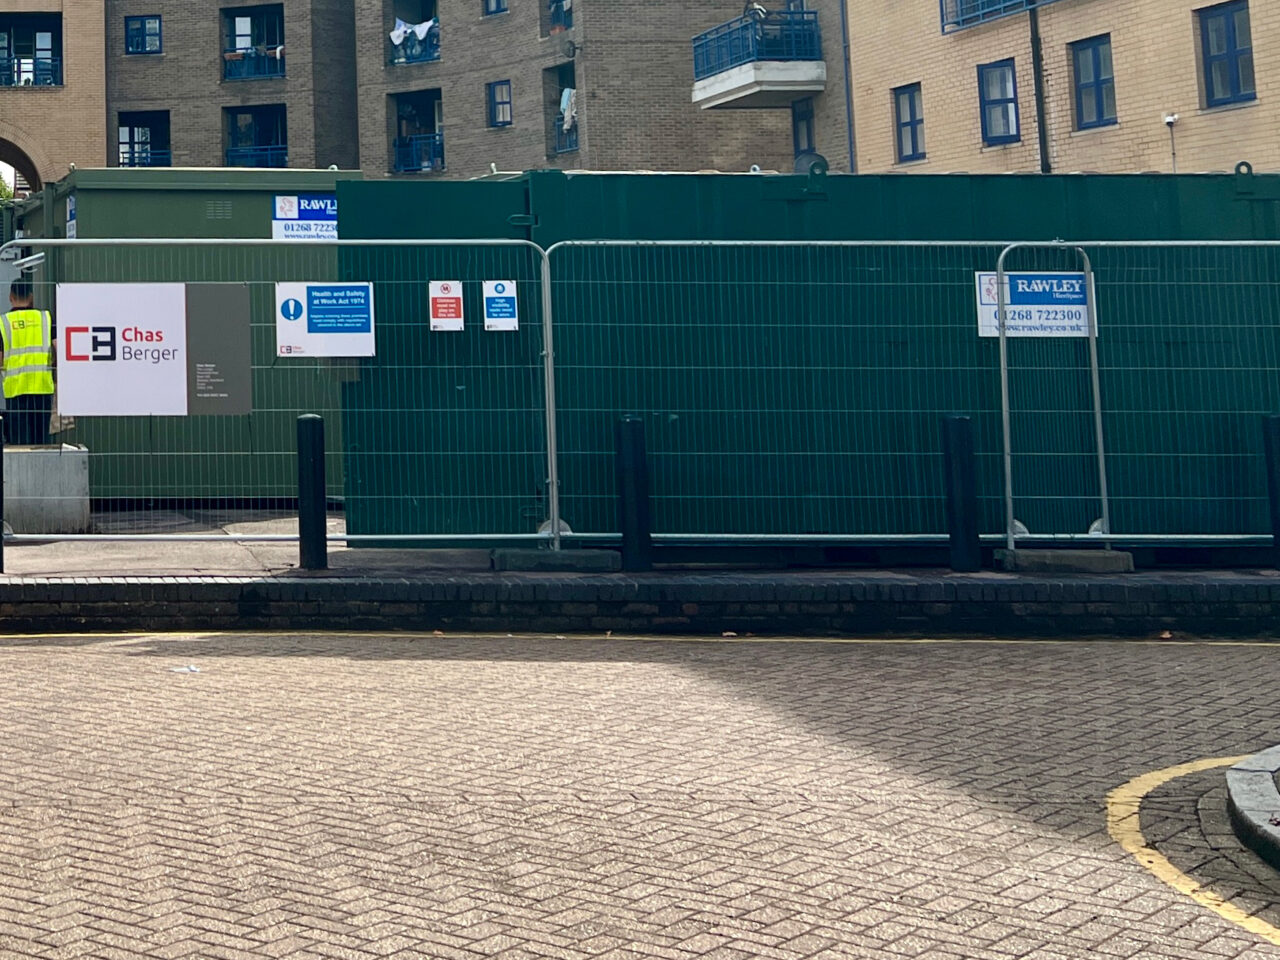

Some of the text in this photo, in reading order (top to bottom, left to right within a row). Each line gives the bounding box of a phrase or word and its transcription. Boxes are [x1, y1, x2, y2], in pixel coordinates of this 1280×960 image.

[284, 223, 312, 232] 01268
[1016, 279, 1082, 292] RAWLEY
[346, 290, 366, 298] Safety
[1036, 309, 1082, 321] 722300
[121, 326, 164, 342] Chas
[122, 345, 179, 364] Berger
